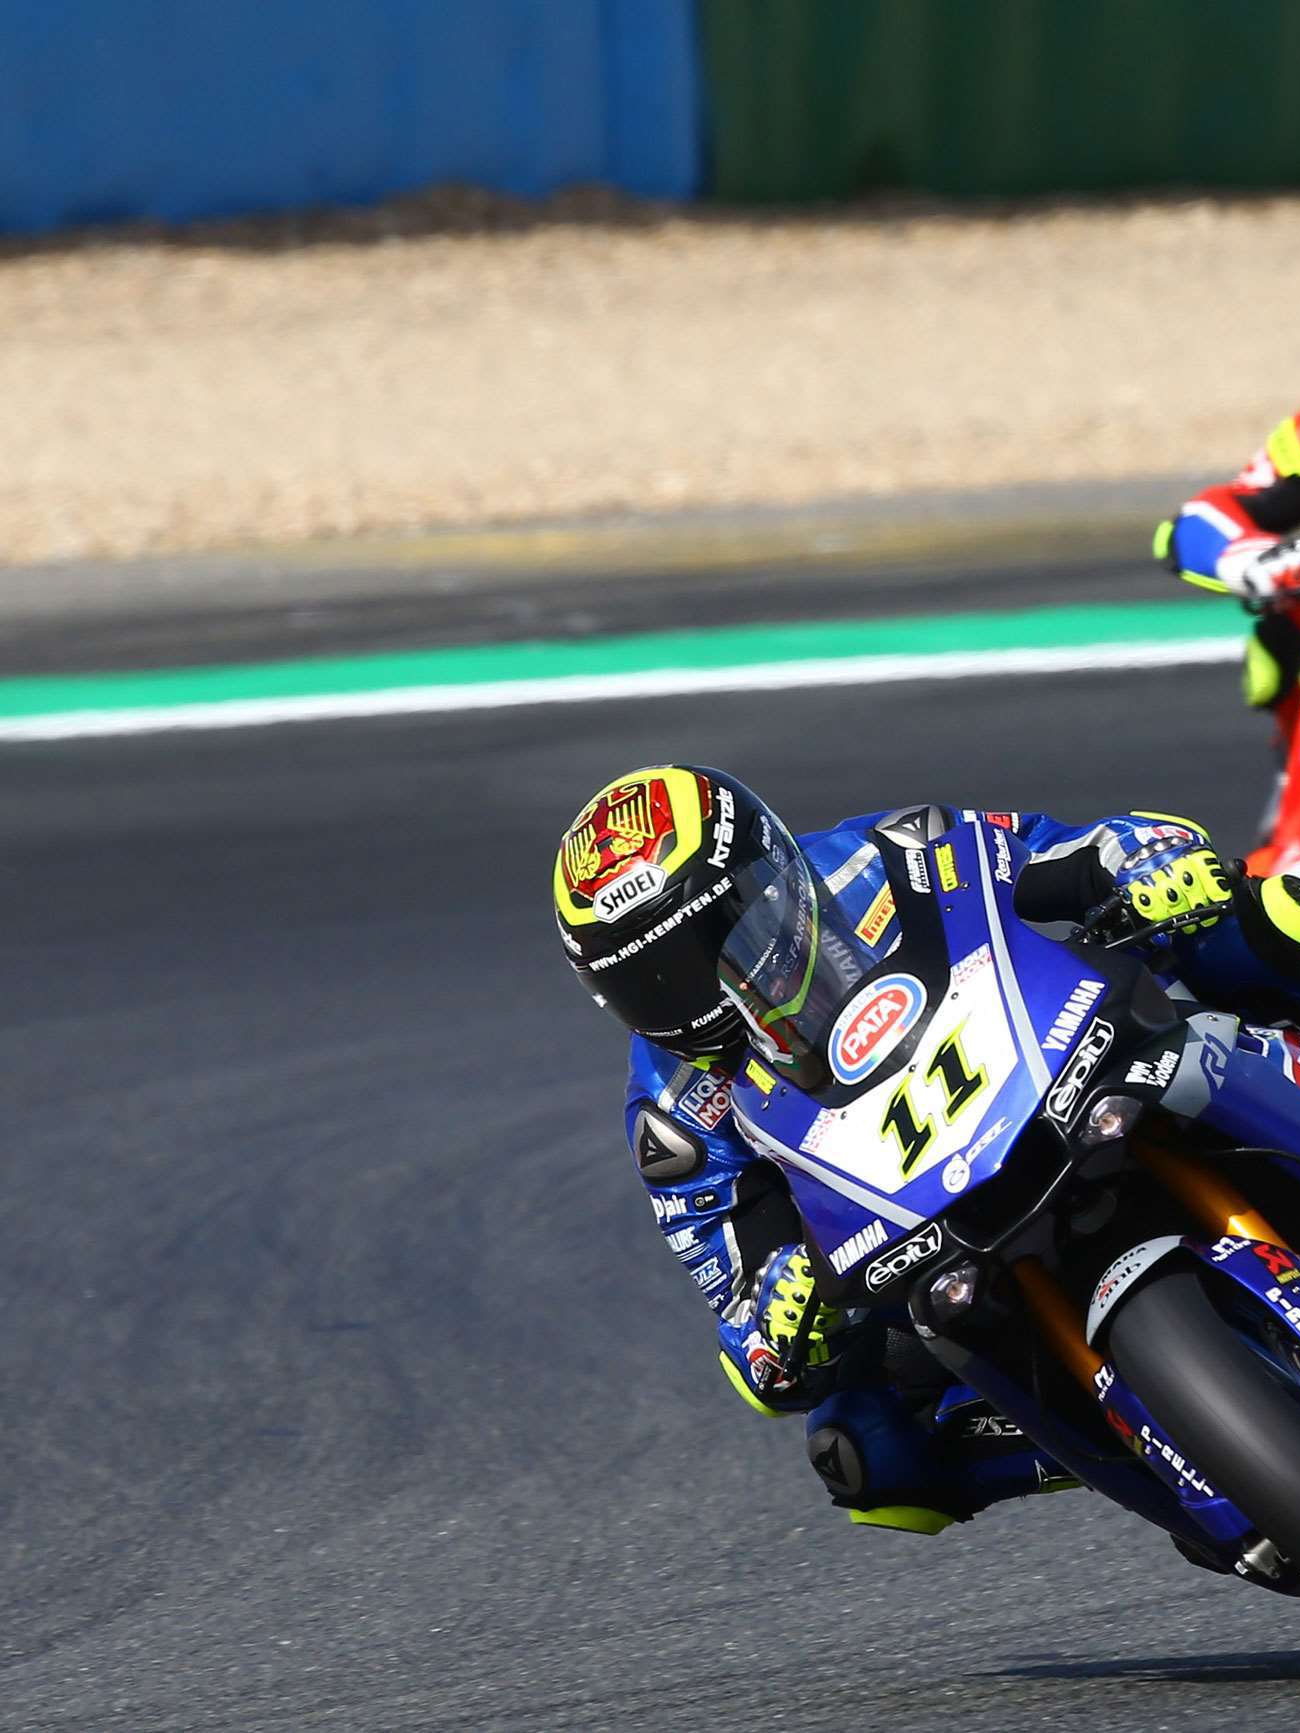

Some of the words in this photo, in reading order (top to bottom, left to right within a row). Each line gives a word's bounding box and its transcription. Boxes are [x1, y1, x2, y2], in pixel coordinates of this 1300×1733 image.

[600, 871, 656, 915] SHOEI
[691, 1005, 724, 1030] KUHN
[842, 998, 904, 1060] PATA
[1041, 979, 1105, 1051] YAMAHA
[880, 1020, 990, 1183] 11
[828, 1219, 889, 1276] YAMAHA
[1140, 1424, 1215, 1498] PIRELLI
